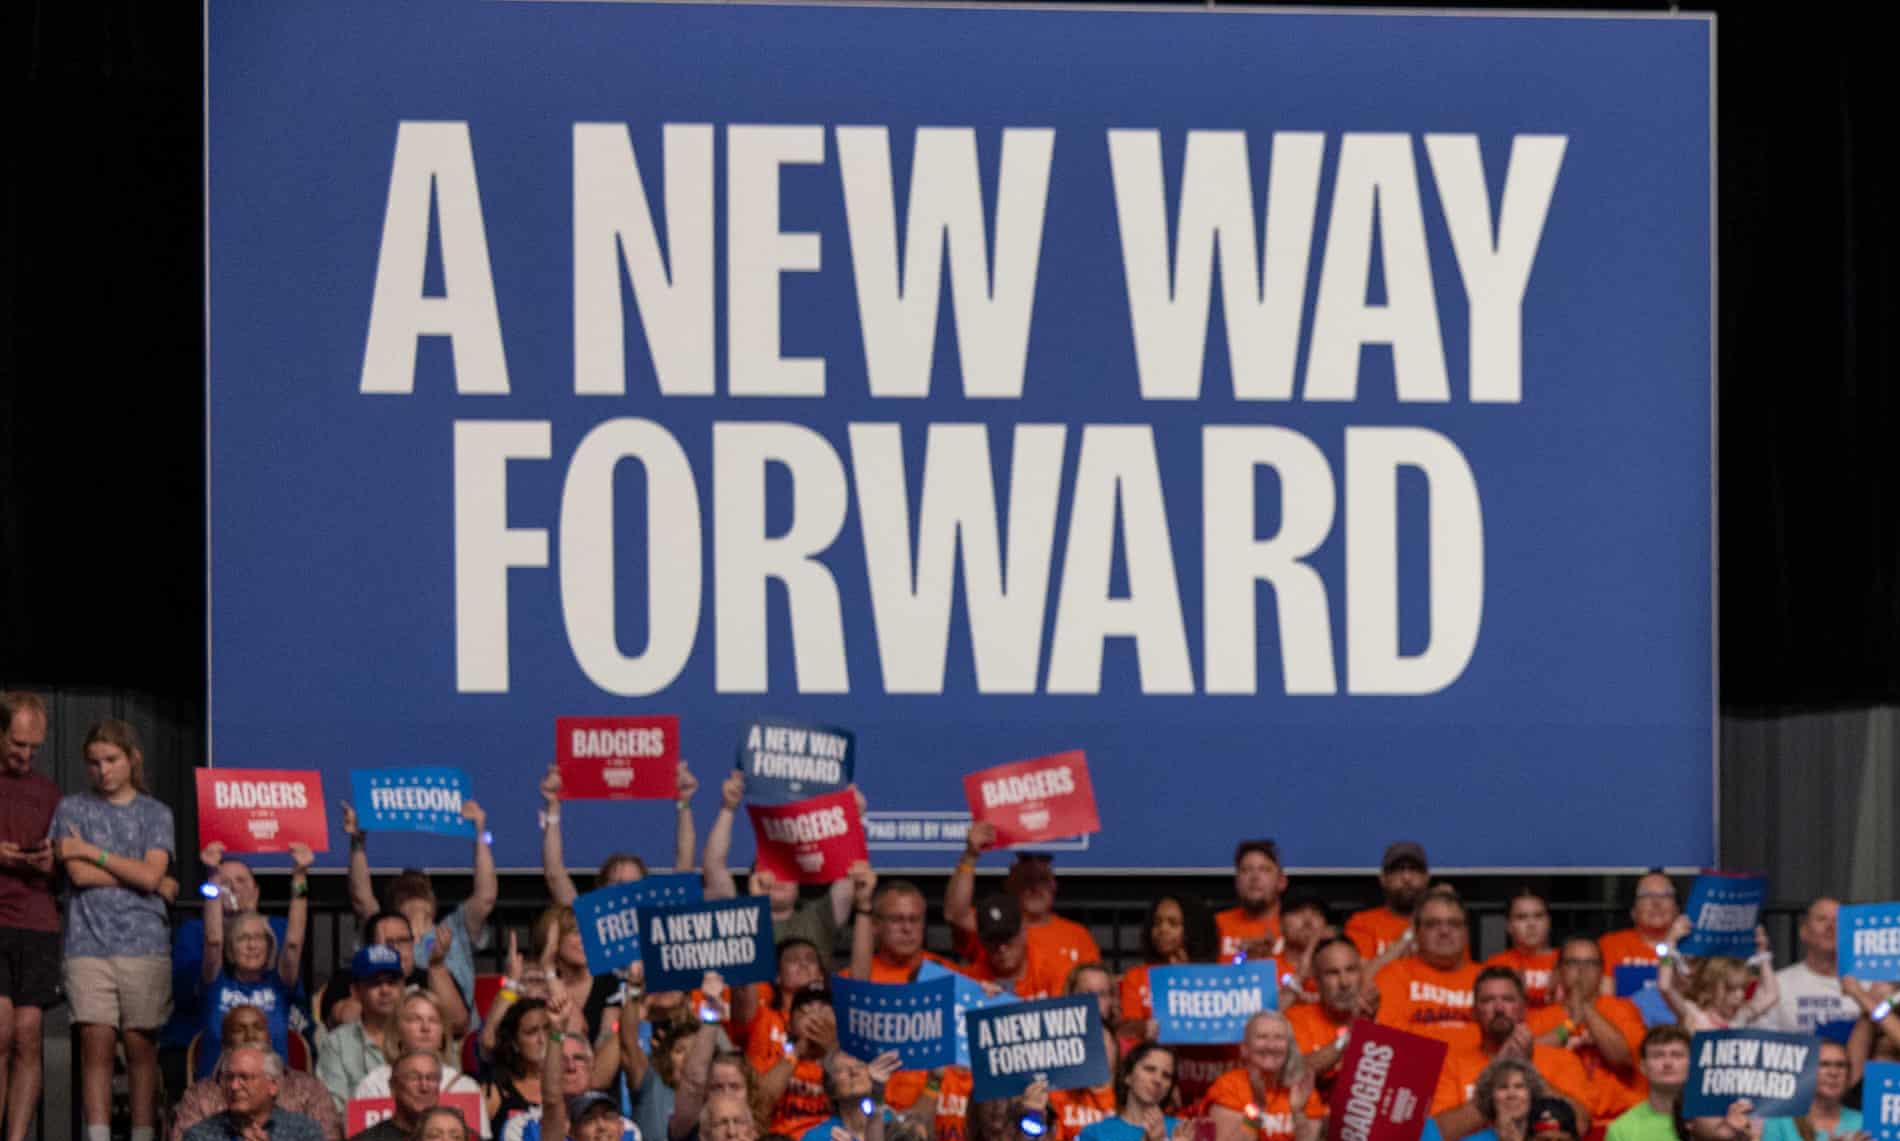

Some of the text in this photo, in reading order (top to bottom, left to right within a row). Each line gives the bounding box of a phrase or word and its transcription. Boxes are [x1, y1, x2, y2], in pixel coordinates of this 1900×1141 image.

[360, 120, 1568, 403] A NEW WAY
[453, 416, 1484, 699] FORWARD
[572, 728, 664, 758] BADGERS
[747, 725, 849, 761] A NEW WAY
[753, 752, 842, 783] FORWARD
[214, 780, 308, 809] BADGERS
[371, 786, 463, 813] FREEDOM
[981, 766, 1075, 809] BADGERS
[762, 806, 849, 843] BADGERS
[651, 917, 666, 945] A
[667, 912, 712, 943] NEW
[716, 905, 760, 939] WAY
[661, 937, 757, 972] FORWARD
[1168, 987, 1262, 1018] FREEDOM
[849, 1007, 943, 1043] FREEDOM
[979, 1020, 994, 1049] A
[995, 1013, 1042, 1043] NEW
[1043, 1005, 1089, 1037] WAY
[988, 1037, 1086, 1077] FORWARD
[1698, 1039, 1810, 1073] A NEW WAY
[1701, 1067, 1797, 1099] FORWARD
